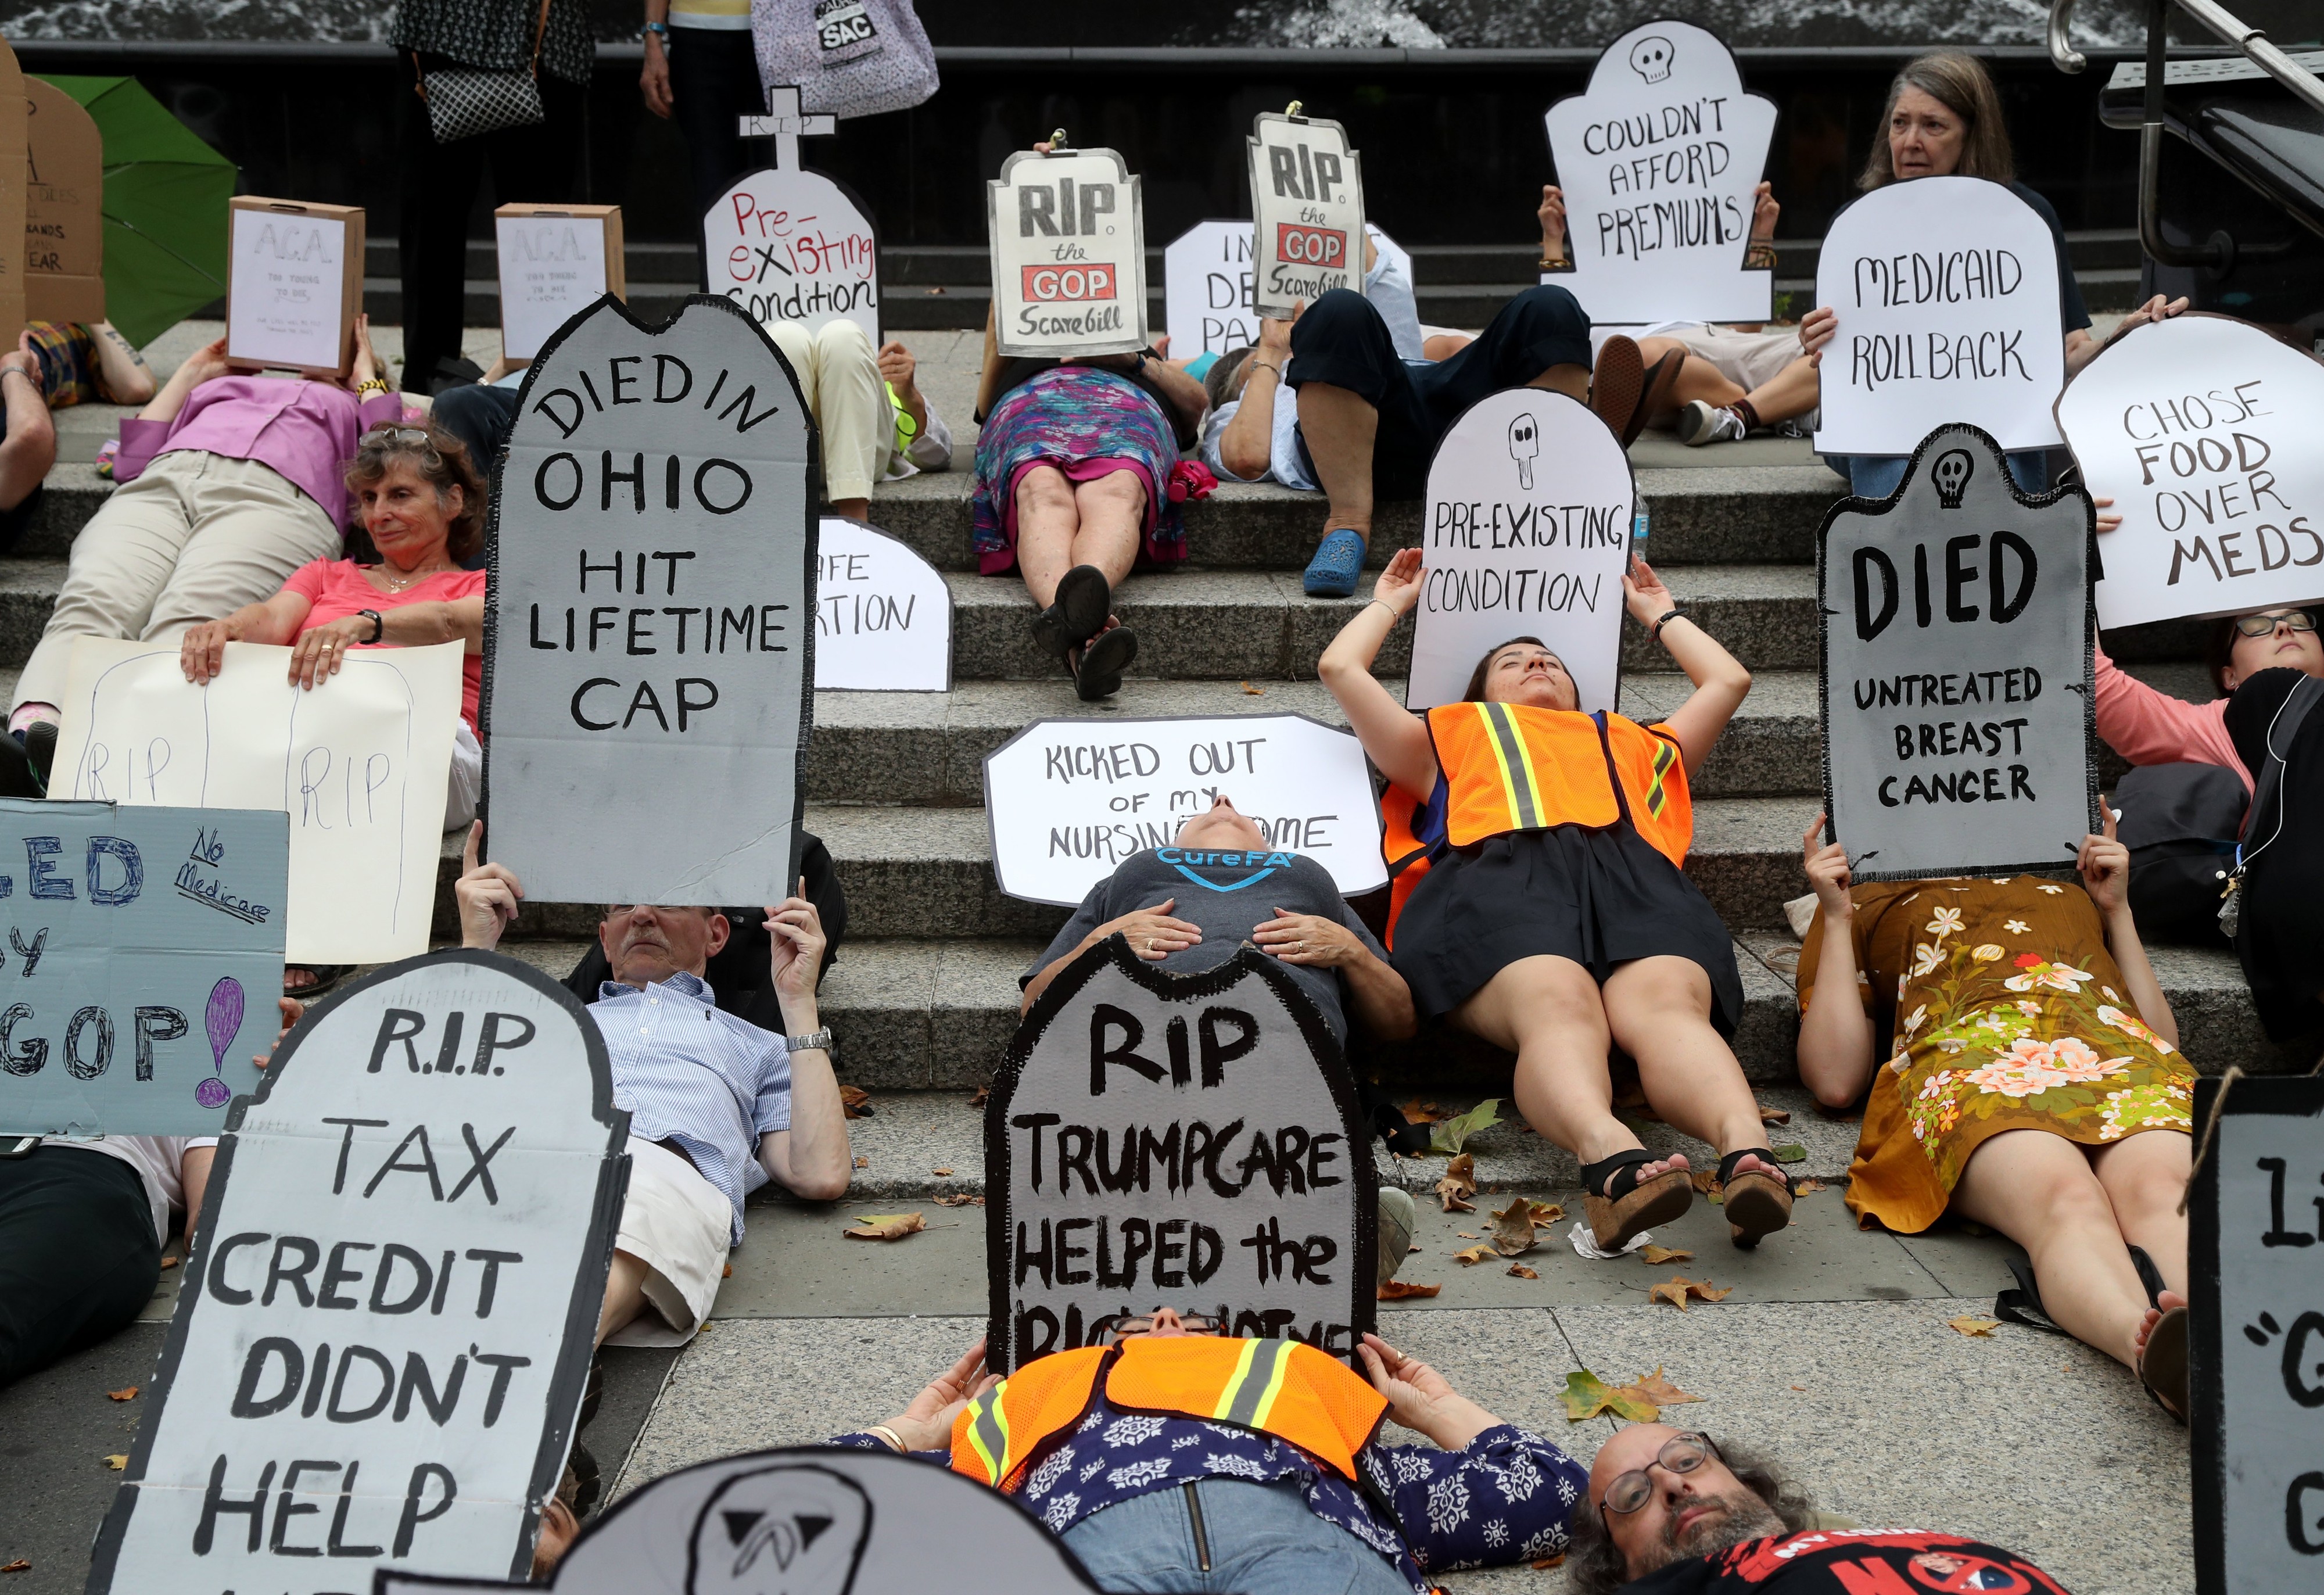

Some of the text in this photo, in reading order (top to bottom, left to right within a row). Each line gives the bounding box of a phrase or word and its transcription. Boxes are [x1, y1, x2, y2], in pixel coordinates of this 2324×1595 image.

[823, 16, 871, 48] SAC
[1583, 97, 1727, 156] COULDN'T
[1609, 141, 1730, 195] AFFORD
[26, 224, 65, 239] SANDS
[732, 193, 816, 237] Pre-
[1299, 206, 1326, 227] the
[1598, 195, 1744, 261] PREMIUMS
[729, 230, 873, 284] existing
[1050, 243, 1089, 261] the
[1285, 230, 1342, 263] GOP
[1032, 268, 1110, 300] GOP
[1854, 249, 2022, 307] MEDICAID
[1017, 305, 1124, 336] Scarebill
[1852, 329, 2033, 391] ROLLBACK
[533, 354, 779, 439] DIED IN
[2124, 380, 2274, 440] CHOSE
[534, 450, 754, 515] OHIO
[2135, 432, 2271, 486] FOOD
[1434, 501, 1623, 550] PRE-EXISTING
[2156, 471, 2291, 532] OVER
[580, 549, 696, 596] HIT
[2167, 517, 2324, 586] MEDS
[1428, 568, 1601, 614] CONDITION
[1852, 531, 2038, 643] DIED
[530, 603, 790, 655] LIFETIME
[571, 678, 719, 733] CAP
[1854, 666, 2042, 711] UNTREATED
[1045, 738, 1267, 784] KICKED OUT
[1894, 718, 2029, 761] BREAST
[88, 737, 171, 802] RIP
[300, 747, 390, 830] RIP
[1878, 765, 2036, 807] CANCER
[1109, 787, 1218, 813] OF MY
[190, 826, 225, 862] No
[1049, 820, 1188, 865] NURSIN
[0, 836, 144, 908] ED
[175, 861, 271, 920] Medicare
[367, 1009, 536, 1076] R.I.P.
[1089, 1003, 1261, 1097] RIP
[322, 1118, 517, 1206] TAX
[1010, 1113, 1347, 1201] TRUMPCARE
[207, 1232, 523, 1319] CREDIT
[1015, 1215, 1338, 1293] HELPED the
[231, 1336, 532, 1429] DIDN'T
[192, 1453, 457, 1559] HELP
